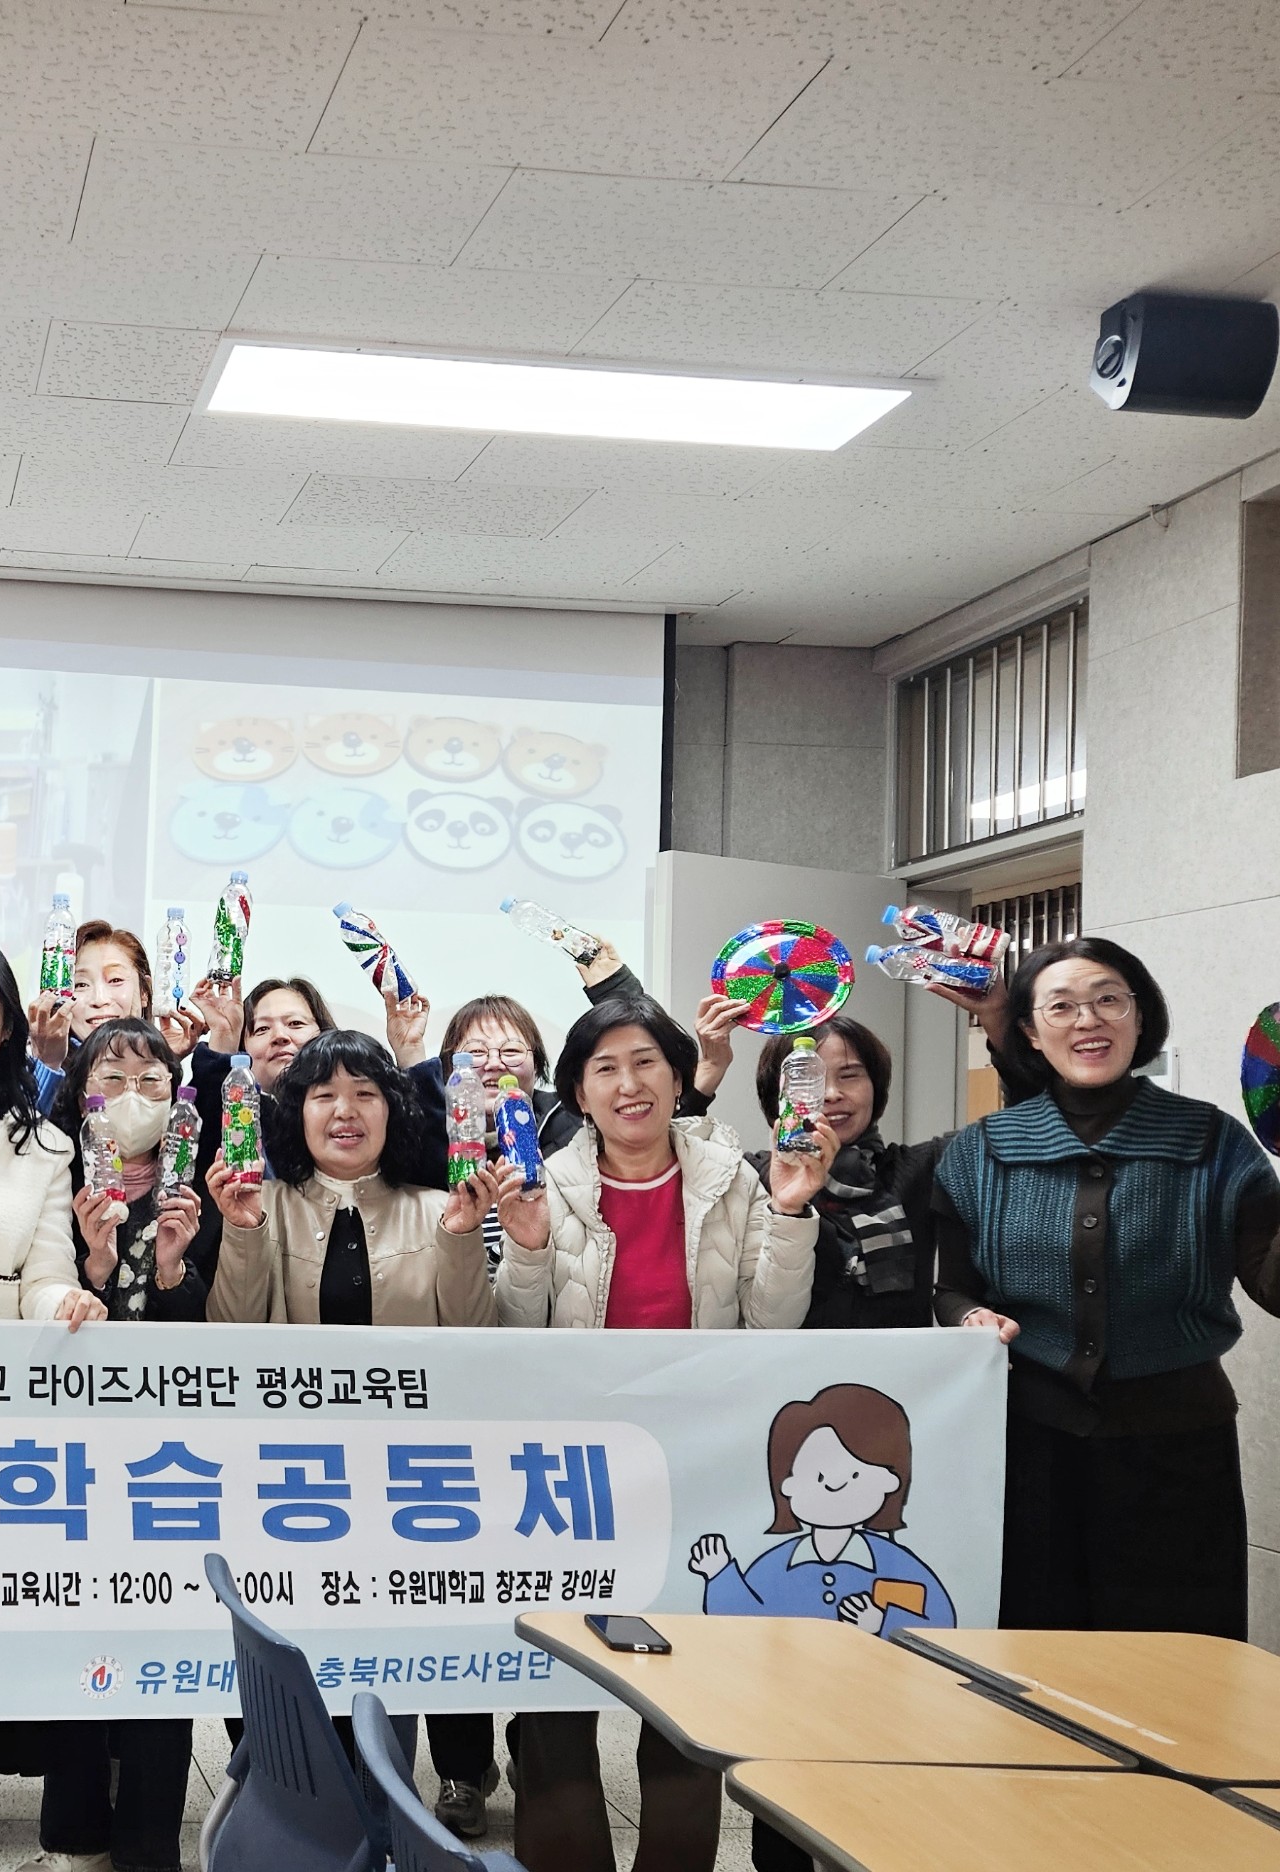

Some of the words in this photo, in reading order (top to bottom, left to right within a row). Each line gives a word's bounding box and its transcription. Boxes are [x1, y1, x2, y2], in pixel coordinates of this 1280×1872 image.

[28, 1364, 240, 1408] 라이즈사업단
[256, 1367, 429, 1410] 평생교육팀
[1, 1571, 82, 1608] 교육시간
[109, 1571, 173, 1605] 12:00
[216, 1570, 294, 1605] :00시
[321, 1570, 362, 1607] 장소
[388, 1569, 486, 1606] 유원대학교
[496, 1569, 554, 1605] 창조관
[561, 1568, 617, 1602] 강의실
[135, 1659, 237, 1695] 유원대
[316, 1651, 556, 1689] 충북RISE사업단
